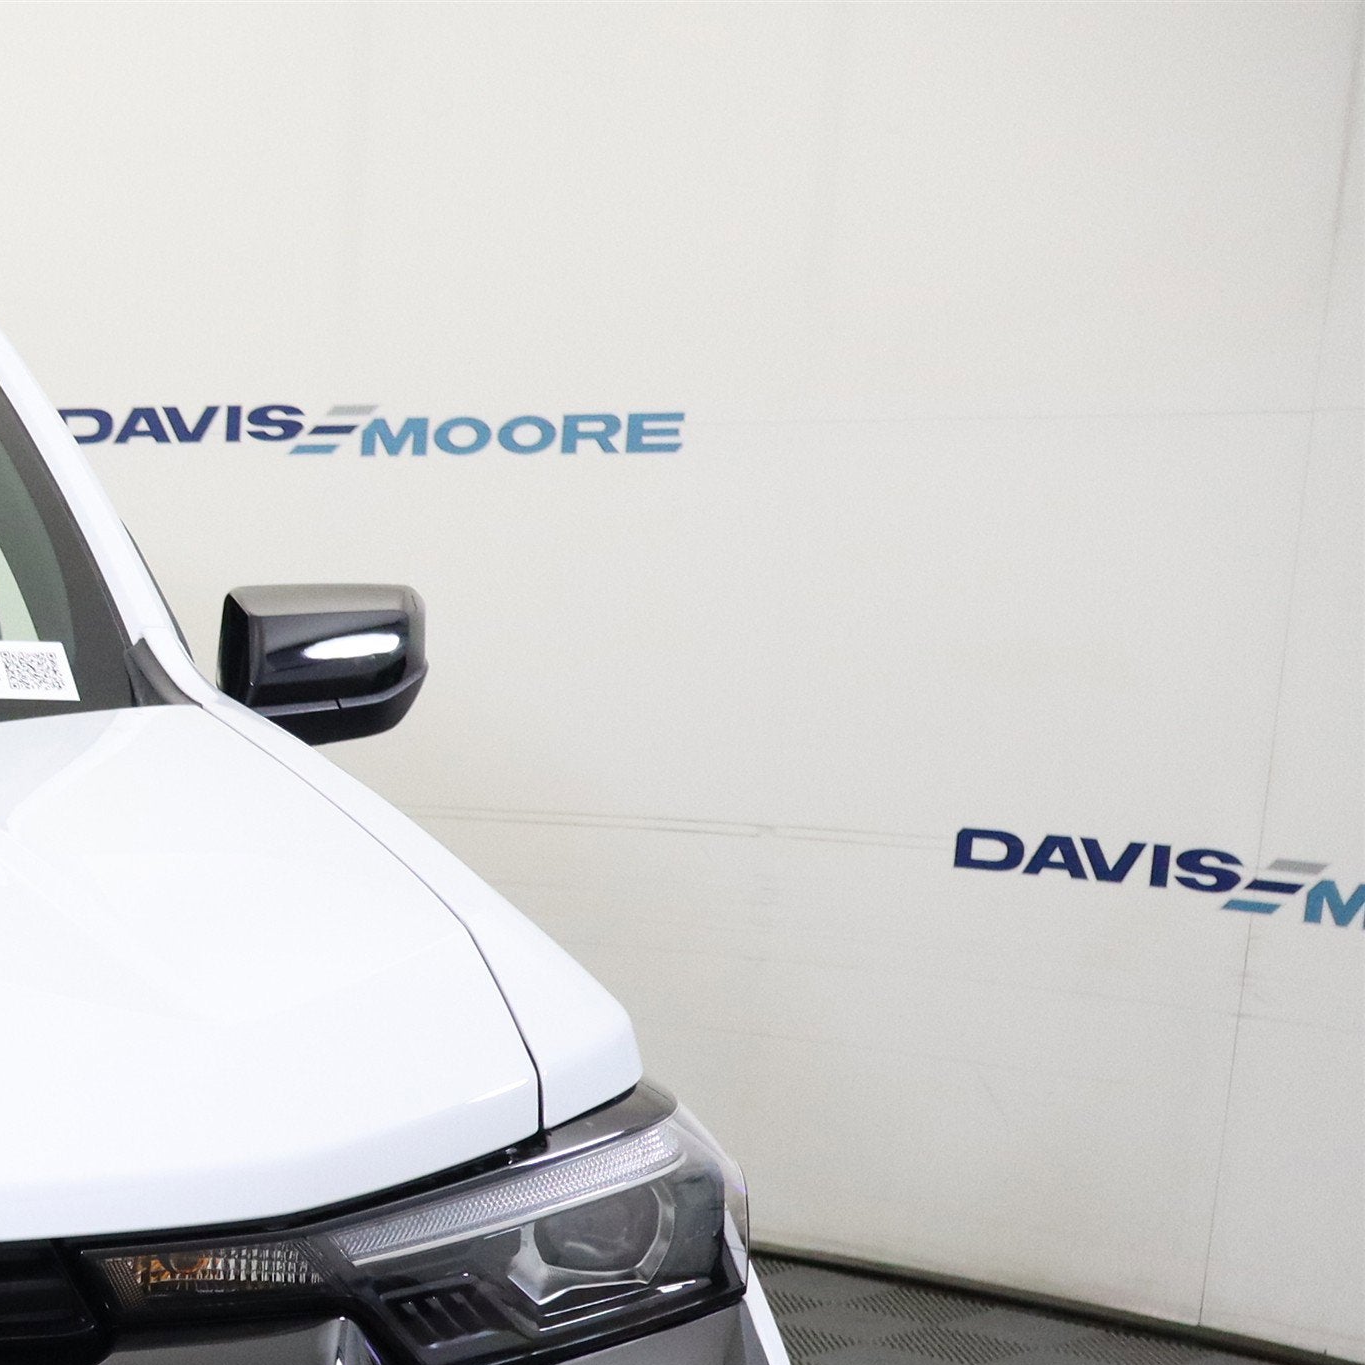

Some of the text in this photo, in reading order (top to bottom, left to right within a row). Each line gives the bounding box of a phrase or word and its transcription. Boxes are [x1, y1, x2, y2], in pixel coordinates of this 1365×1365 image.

[57, 405, 686, 456] DAVIS MOORE
[953, 827, 1243, 893] DAVIS
